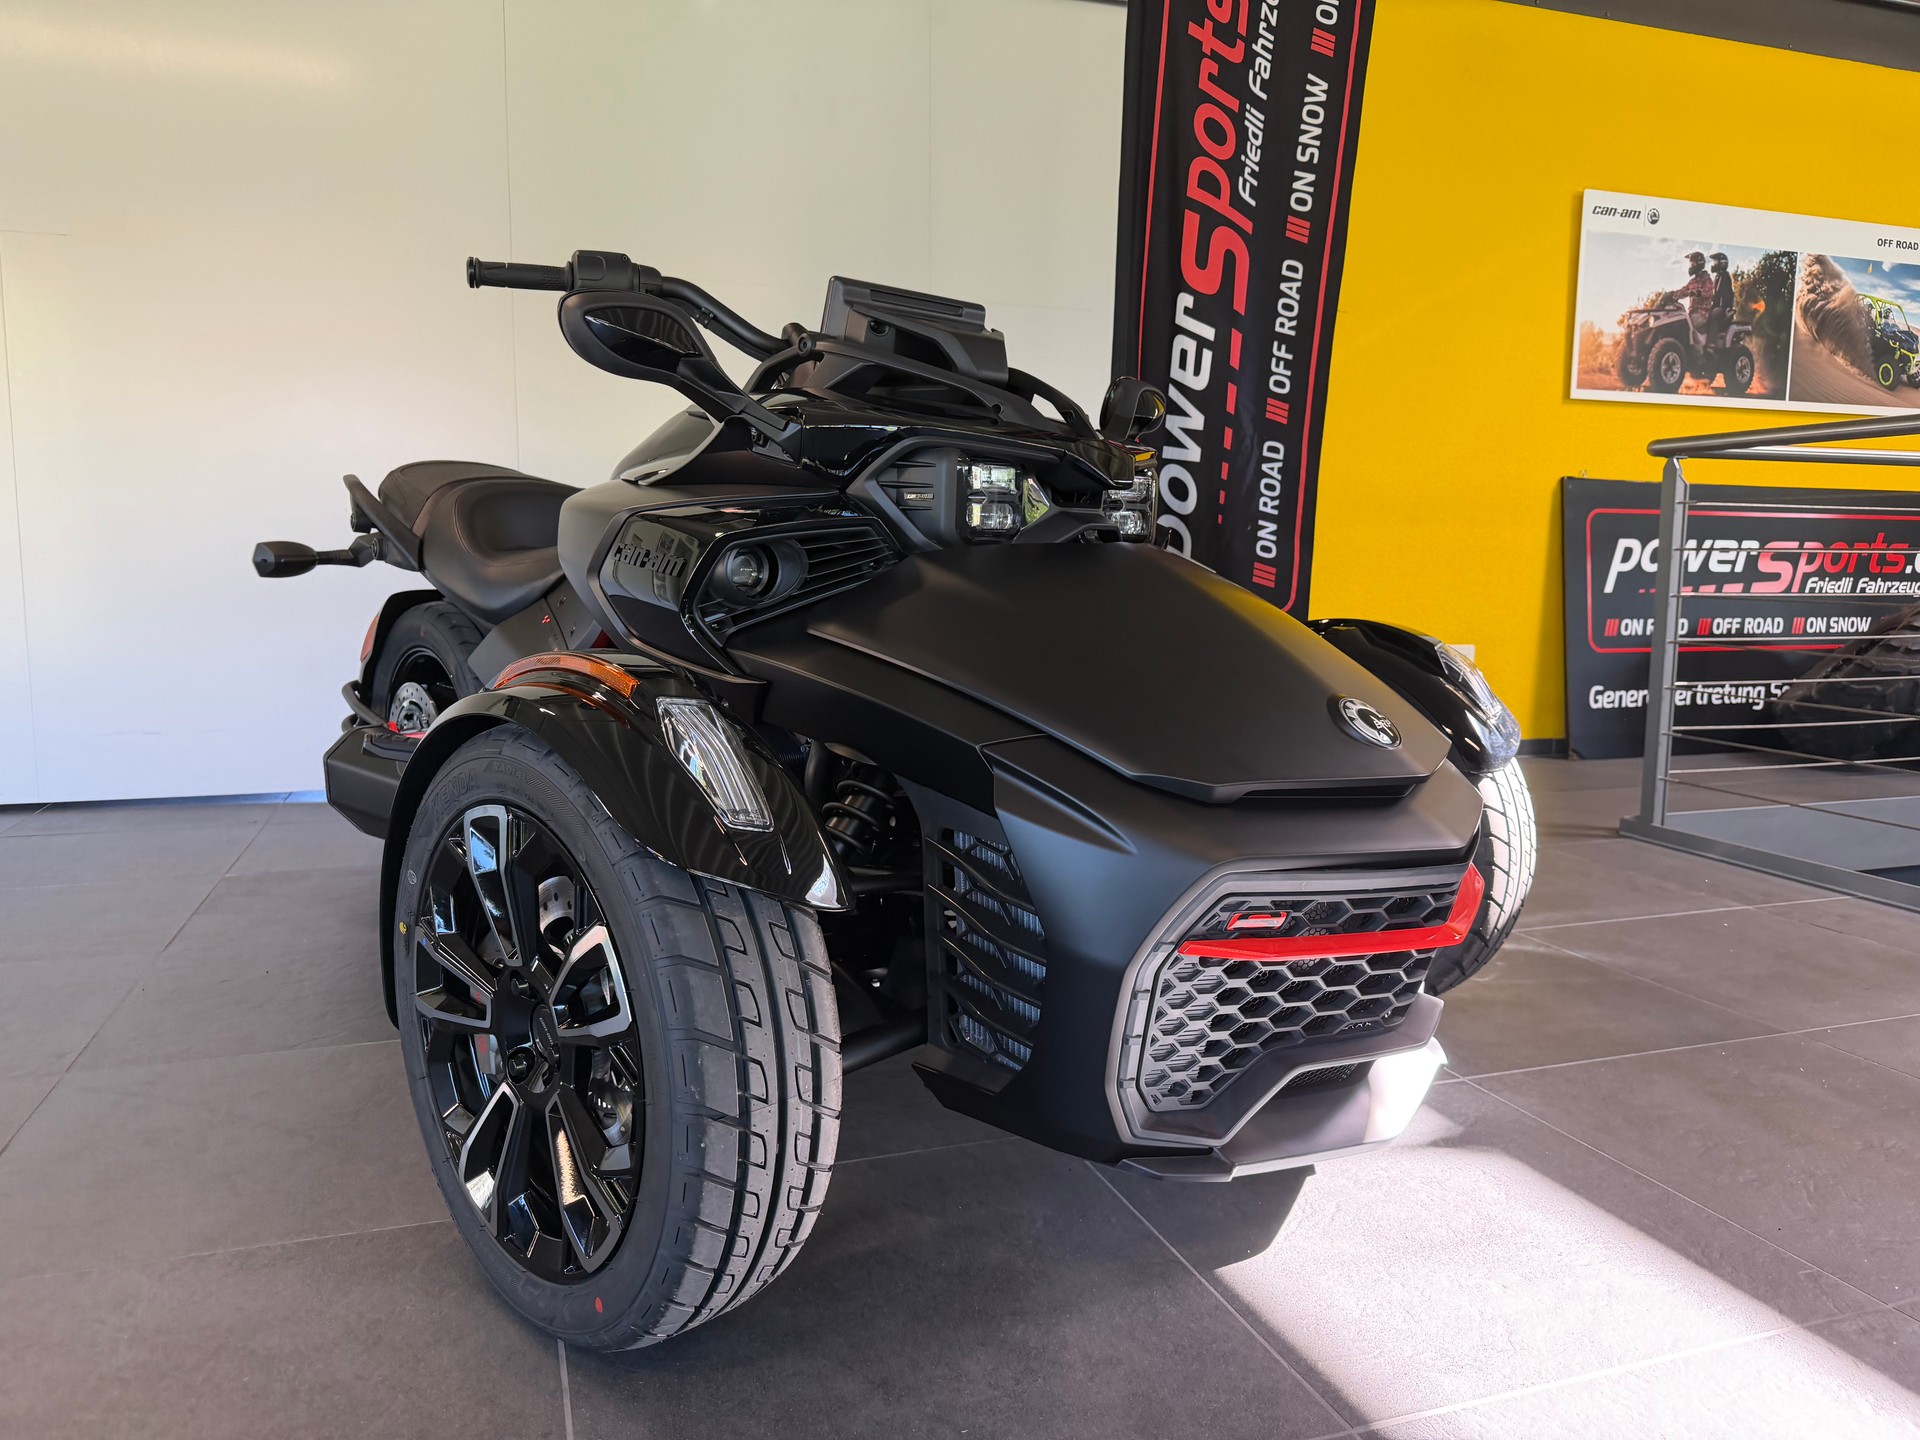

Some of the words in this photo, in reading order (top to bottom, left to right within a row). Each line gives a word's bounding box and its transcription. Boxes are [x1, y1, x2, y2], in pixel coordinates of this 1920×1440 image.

[1296, 72, 1329, 165] SNOW
[1238, 103, 1265, 207] Friedli
[1290, 170, 1317, 213] ON
[1592, 205, 1642, 220] can-am
[1877, 238, 1894, 248] OFF
[1896, 240, 1919, 251] ROAD
[1274, 258, 1304, 337] ROAD
[1269, 340, 1294, 395] OFF
[1258, 440, 1285, 516] ROAD
[1256, 523, 1278, 559] ON
[612, 542, 688, 577] can-am
[1805, 577, 1854, 594] Friedli
[1620, 619, 1643, 636] ON
[1712, 617, 1742, 635] OFF
[1744, 617, 1784, 635] ROAD
[1806, 616, 1828, 634] ON
[1830, 616, 1872, 634] SNOW
